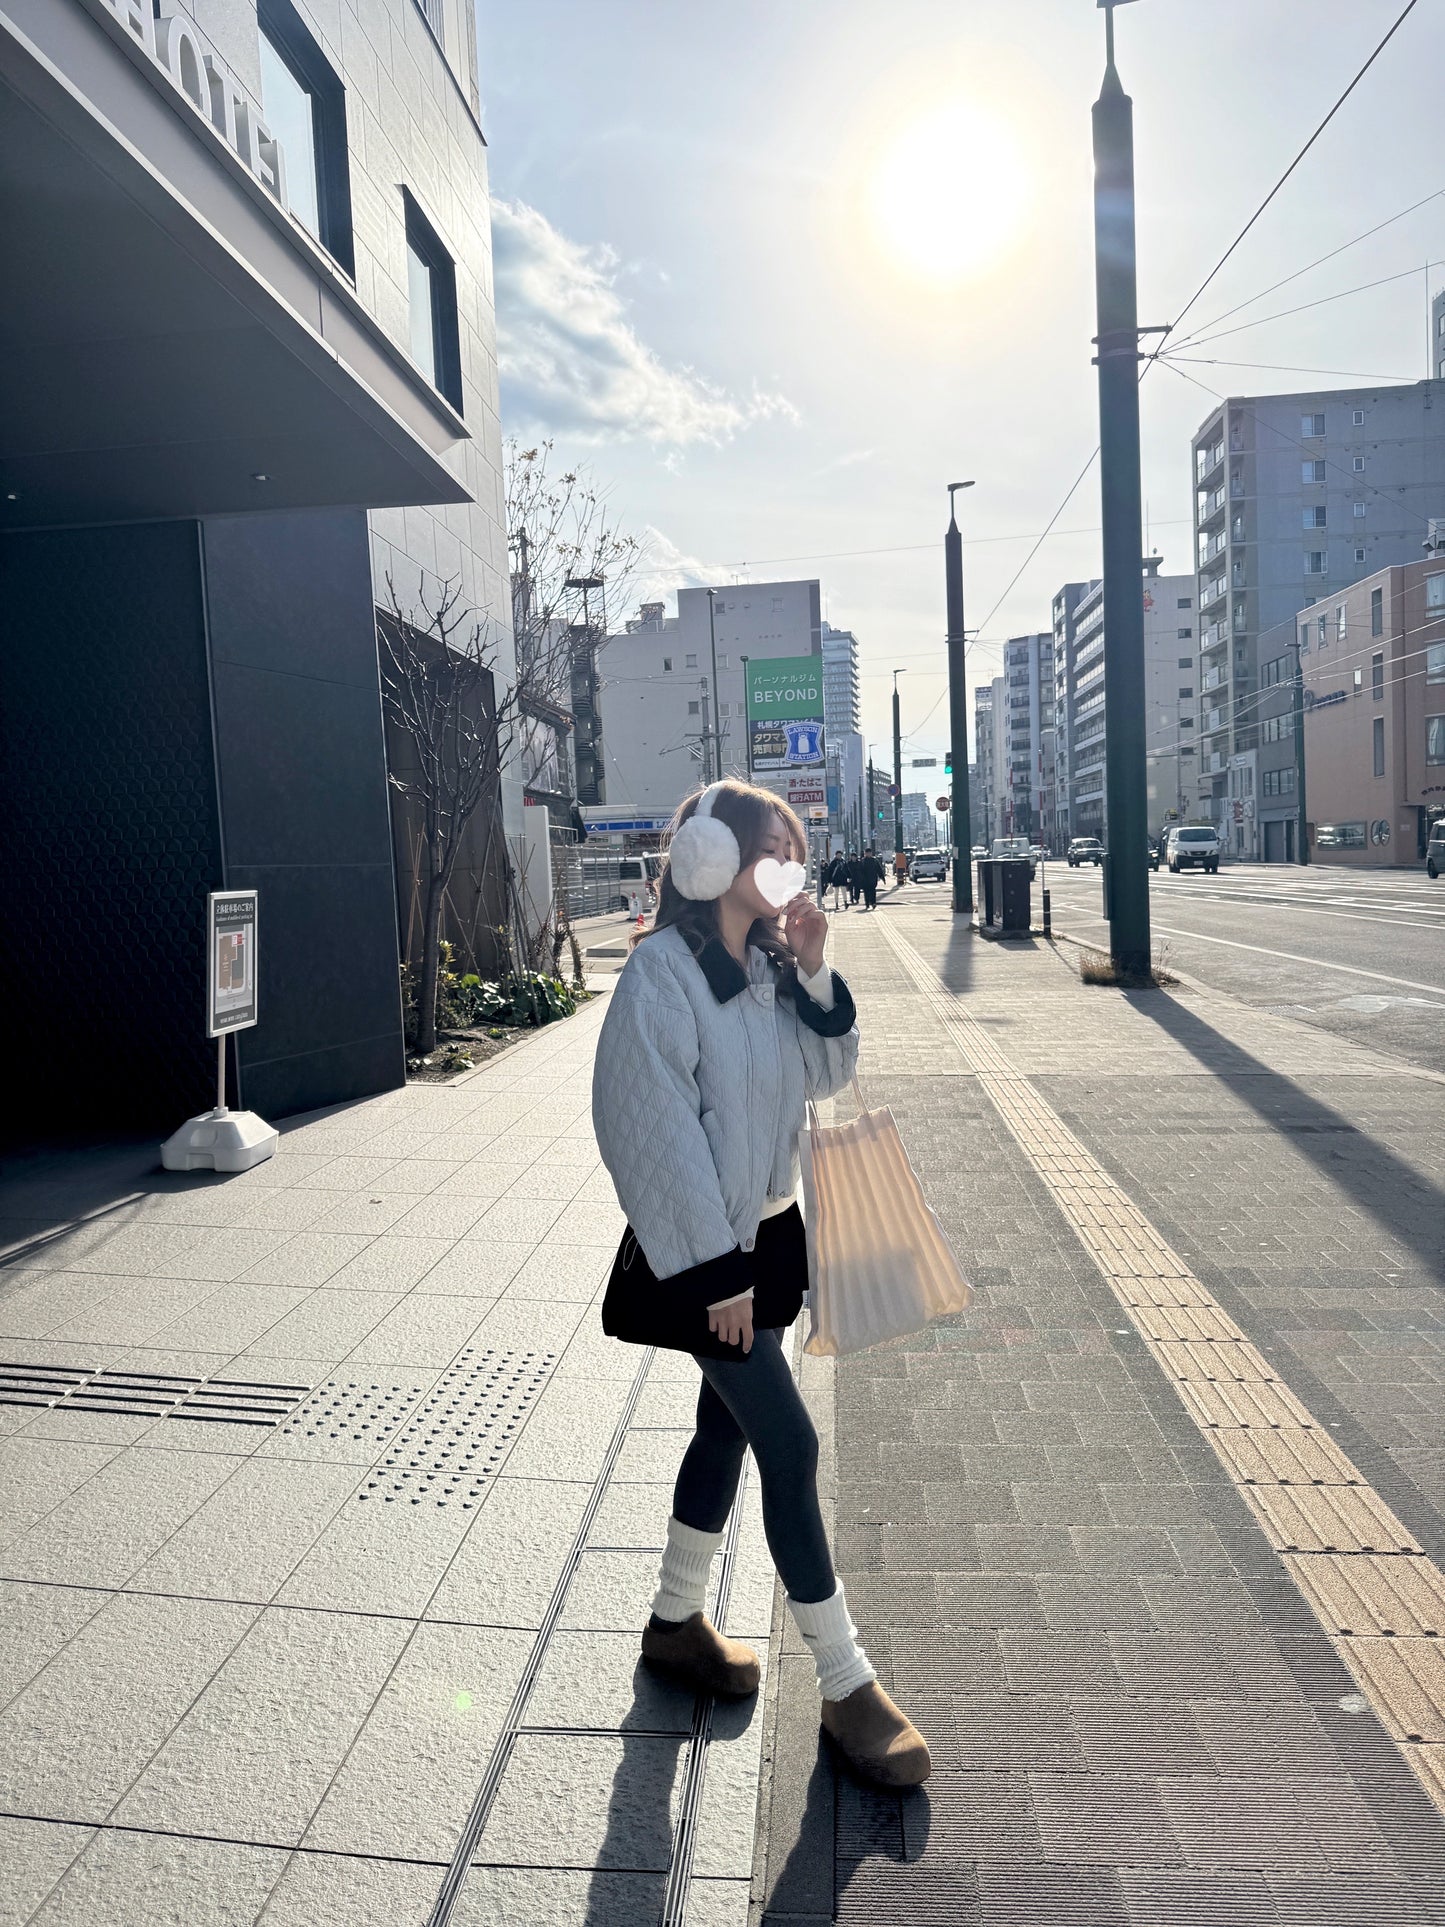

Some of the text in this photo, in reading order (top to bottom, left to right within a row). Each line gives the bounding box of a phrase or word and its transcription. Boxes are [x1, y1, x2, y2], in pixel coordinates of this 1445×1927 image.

[754, 673, 816, 685] パーソナルジム
[754, 688, 818, 703] BEYOND
[788, 726, 818, 735] LAWSON
[789, 752, 819, 760] STATION
[790, 792, 822, 802] 銀行ATM
